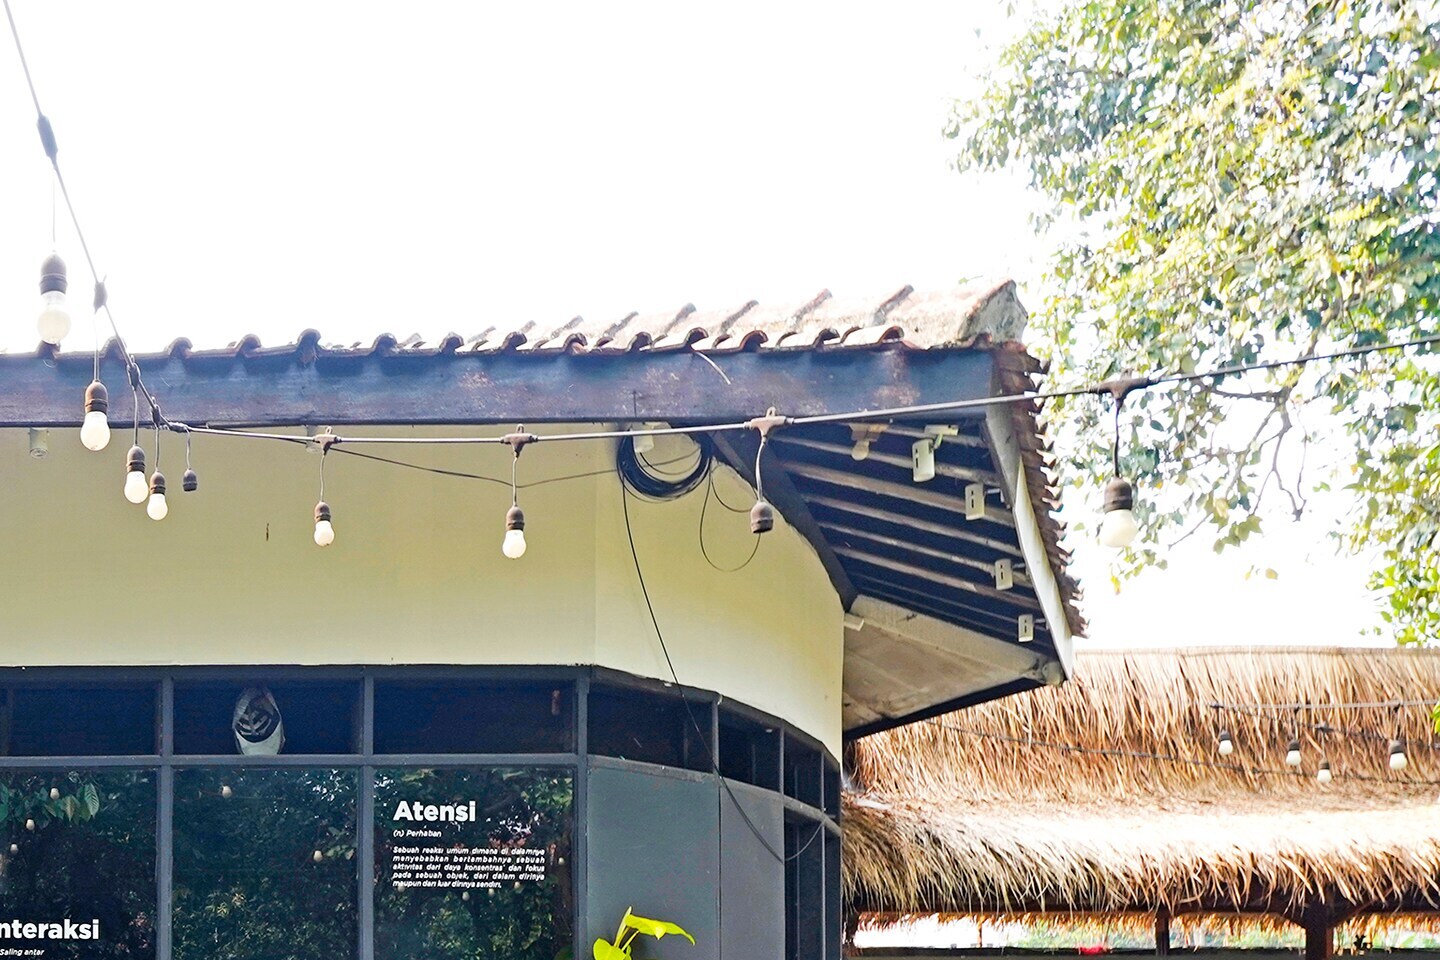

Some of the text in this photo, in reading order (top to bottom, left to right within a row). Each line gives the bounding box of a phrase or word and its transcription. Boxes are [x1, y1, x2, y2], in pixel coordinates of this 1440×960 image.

[393, 801, 476, 821] Atensi
[392, 855, 449, 863] menyebabkan
[453, 856, 512, 864] bertambahnya
[391, 872, 412, 880] pada
[24, 948, 45, 956] antar
